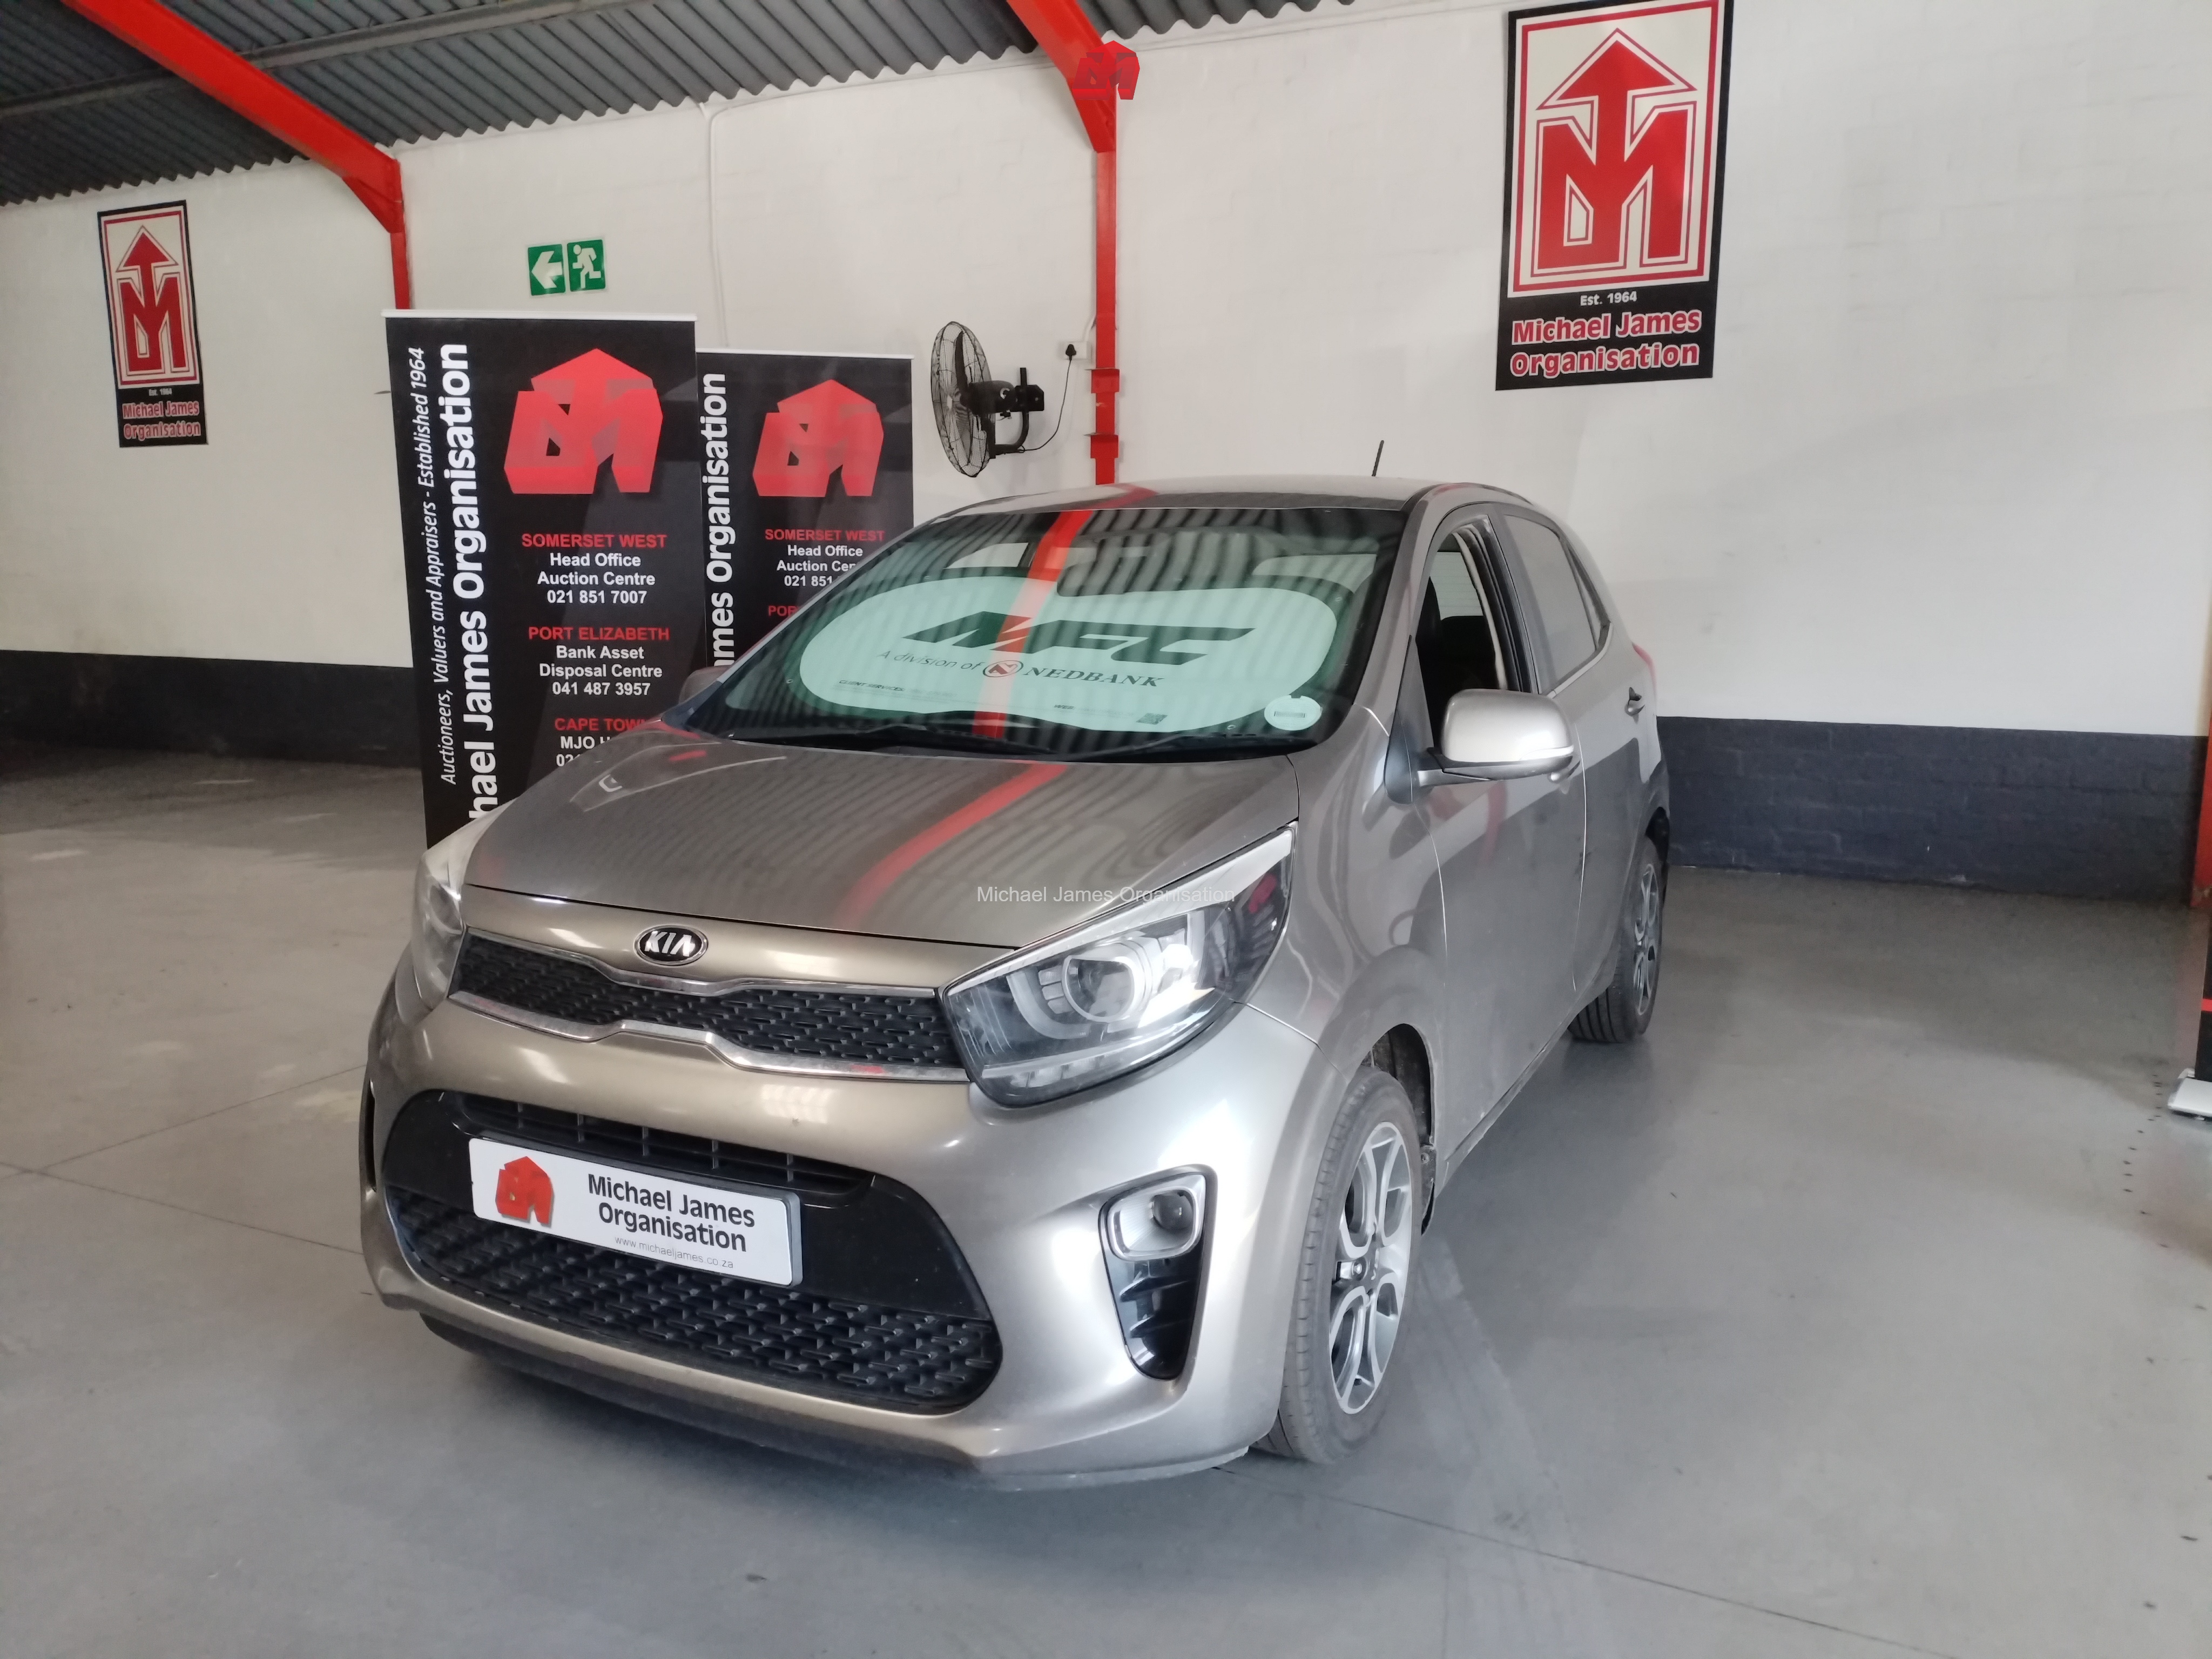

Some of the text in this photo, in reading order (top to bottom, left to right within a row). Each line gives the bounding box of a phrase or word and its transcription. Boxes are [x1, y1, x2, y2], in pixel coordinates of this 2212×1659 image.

[1580, 291, 1638, 307] Est. 1964
[1512, 309, 1702, 346] Michael James
[408, 347, 427, 389] 1964
[1510, 342, 1700, 379] Organisation
[122, 401, 200, 419] Michael James
[124, 420, 201, 441] Organisation
[412, 392, 435, 488] Established
[699, 373, 736, 667] mes Organisation
[522, 533, 667, 549] SOMERSET WEST
[765, 529, 886, 541] SOMERSET WEST
[421, 501, 445, 588] Appraisers
[787, 544, 863, 557] Head Office
[550, 552, 641, 567] Head Office
[777, 559, 828, 571] Auction
[438, 344, 498, 818] hael James Organisation
[537, 571, 656, 585] Auction Centre
[784, 575, 833, 586] 021 851
[426, 589, 444, 622] and
[547, 590, 647, 604] 021 851 7007
[768, 605, 798, 617] POR
[528, 626, 670, 641] PORT ELIZABETH
[430, 625, 449, 683] Valuers
[556, 645, 644, 659] Bank Asset
[539, 663, 663, 680] Disposal Centre
[877, 650, 1164, 687] A division of NEDBANK
[552, 682, 651, 696] 041 487 3957
[555, 718, 647, 731] CAPE TOW
[437, 690, 456, 785] Auctioneers,
[560, 736, 595, 749] MJO
[644, 930, 692, 957] KIA
[588, 1174, 756, 1228] Michael James
[598, 1202, 747, 1252] Organisation
